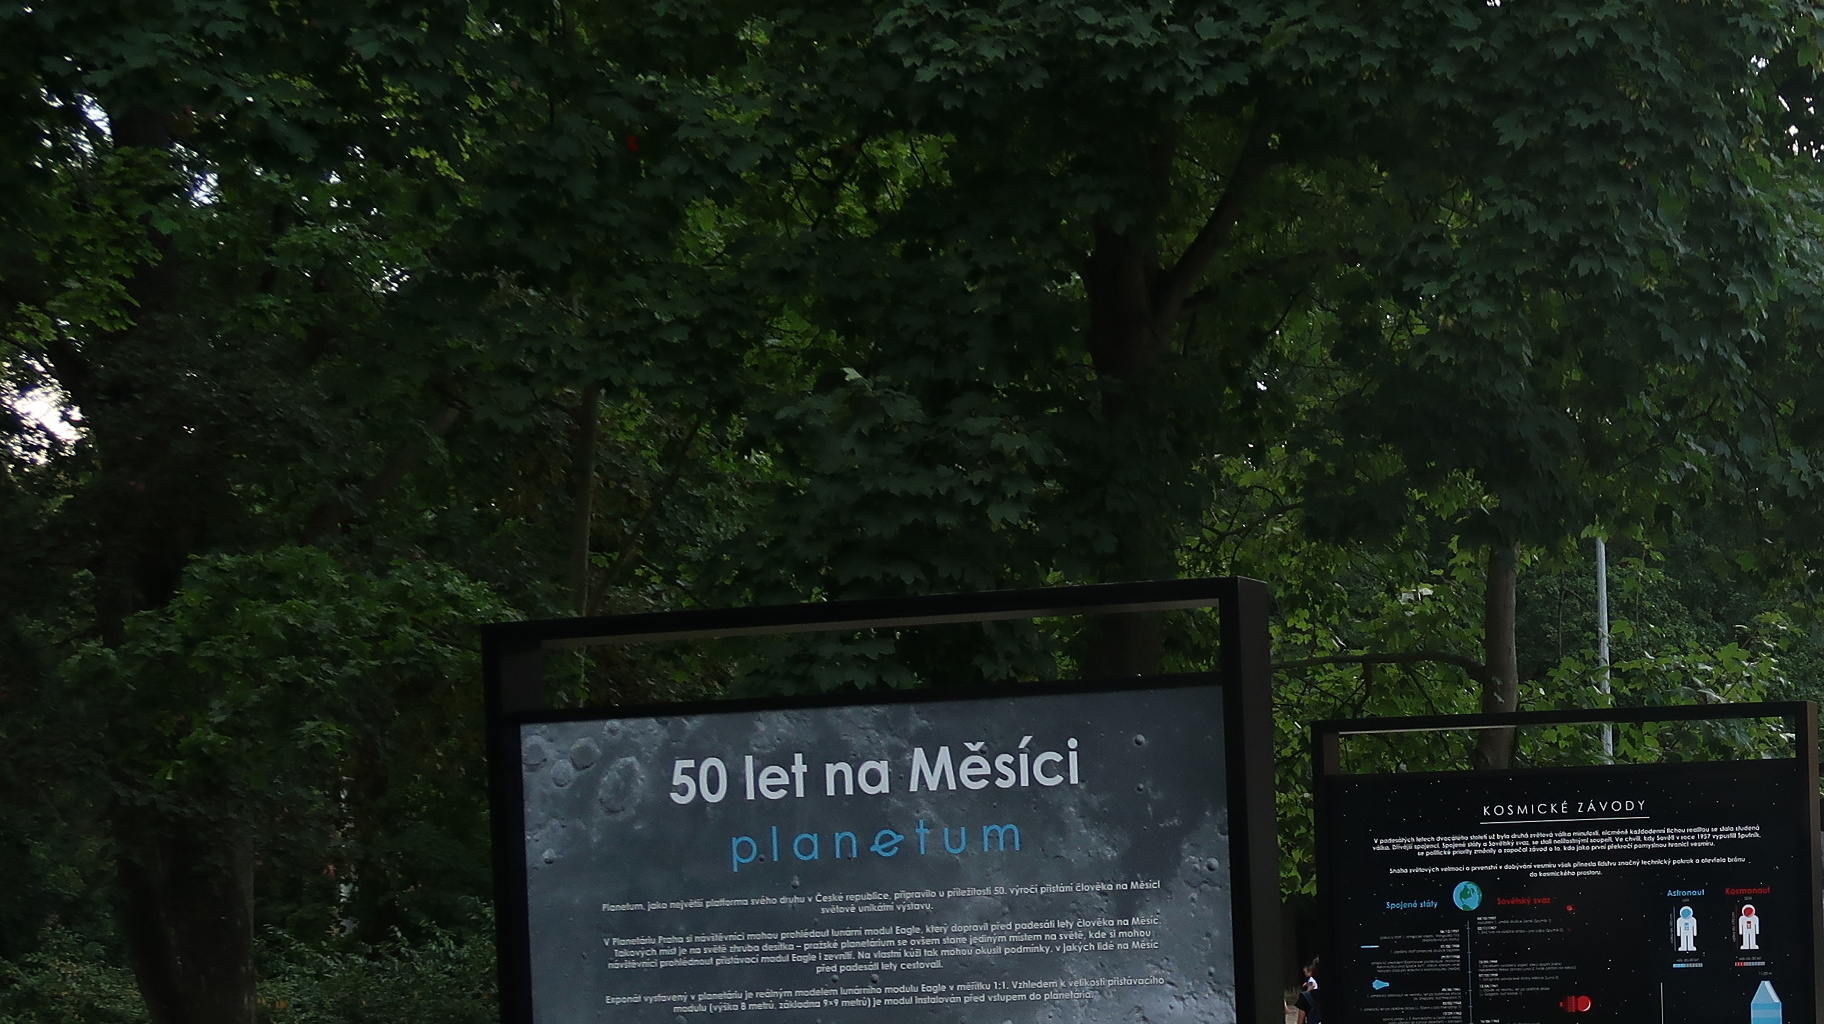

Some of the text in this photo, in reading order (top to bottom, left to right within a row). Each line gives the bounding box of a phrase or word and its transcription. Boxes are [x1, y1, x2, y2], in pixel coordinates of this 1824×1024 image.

[669, 735, 1079, 804] 50 let na Měsíci
[1483, 799, 1645, 816] KOSMICKÉ ZÁVODY
[731, 819, 1020, 873] planetum
[647, 900, 667, 912] jako
[750, 895, 777, 905] svého
[779, 895, 805, 904] druhu
[814, 892, 843, 903] České
[893, 889, 936, 902] připravilo
[946, 887, 991, 900] příležitosti
[993, 886, 1007, 895] 50.
[1009, 884, 1038, 897] výročí
[1039, 883, 1073, 896] přistání
[1075, 882, 1113, 892] člověka
[1130, 880, 1160, 890] Měsíci
[1667, 887, 1770, 897] Astronaut Kosmonaut
[896, 902, 934, 913] výstavu.
[657, 934, 684, 944] Praha
[746, 931, 778, 941] mohou
[831, 927, 861, 937] lunární
[863, 926, 893, 936] modul
[925, 924, 948, 935] který
[950, 922, 988, 935] dopravil
[990, 922, 1012, 933] před
[1014, 920, 1055, 933] padesáti
[1056, 919, 1074, 930] lety
[1076, 918, 1114, 928] člověka
[1131, 916, 1162, 926] Měsíc.
[702, 944, 727, 954] světě
[729, 943, 759, 953] zhruba
[840, 938, 895, 951] planetárium
[909, 936, 940, 946] ovšem
[942, 936, 967, 945] stane
[969, 934, 1006, 946] jediným
[1088, 930, 1106, 939] kde
[1117, 929, 1151, 938] mohou
[760, 953, 790, 963] modul
[791, 952, 817, 964] Eagle
[872, 949, 902, 959] vlastní
[923, 948, 938, 957] tak
[940, 947, 973, 957] mohou
[974, 946, 1002, 955] okusit
[1062, 942, 1095, 954] jakých
[1131, 940, 1158, 950] Měsíc
[815, 960, 943, 975] před padesáti lety cestovali.
[794, 987, 838, 997] modelem
[840, 985, 882, 995] lunárního
[884, 984, 918, 994] modulu
[920, 983, 946, 994] Eagle
[994, 981, 1009, 990] 1:1.
[1012, 980, 1058, 990] Vzhledem
[1107, 975, 1164, 989] přistávacího
[672, 1003, 707, 1013] modulu
[840, 997, 871, 1009] metrů)
[883, 996, 913, 1006] modul
[914, 994, 961, 1005] instalován
[963, 994, 985, 1006] před
[987, 993, 1027, 1004] vstupem
[1043, 990, 1096, 1003] planetária.
